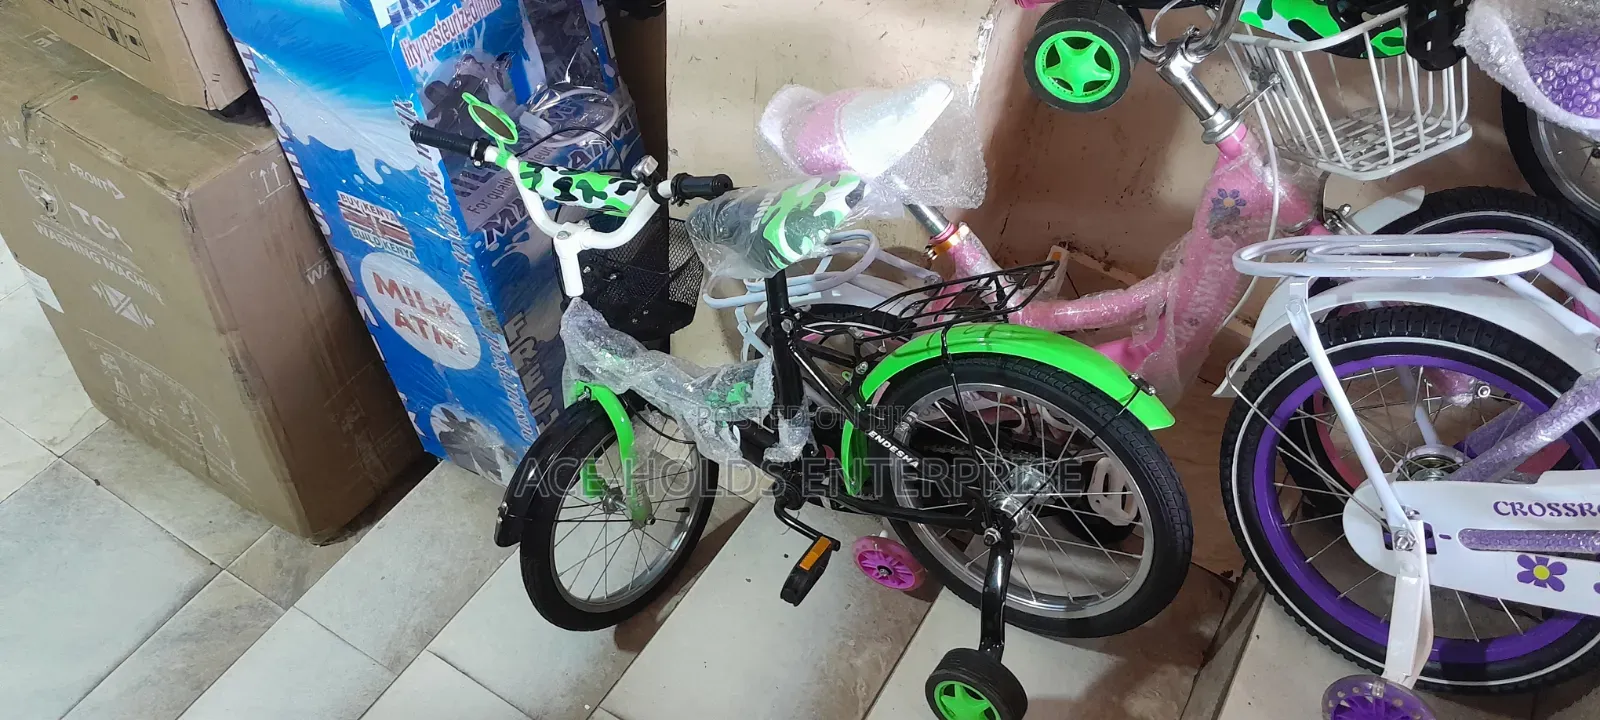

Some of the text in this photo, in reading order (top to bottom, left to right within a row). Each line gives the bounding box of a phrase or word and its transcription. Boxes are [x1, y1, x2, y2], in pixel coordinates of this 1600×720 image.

[69, 162, 109, 192] FRONT
[363, 203, 396, 223] KENYA
[467, 197, 489, 215] For
[32, 220, 101, 265] WASHING
[351, 230, 419, 264] BUILD KENYA
[372, 271, 459, 327] MILK
[868, 430, 919, 469] ENDESHA
